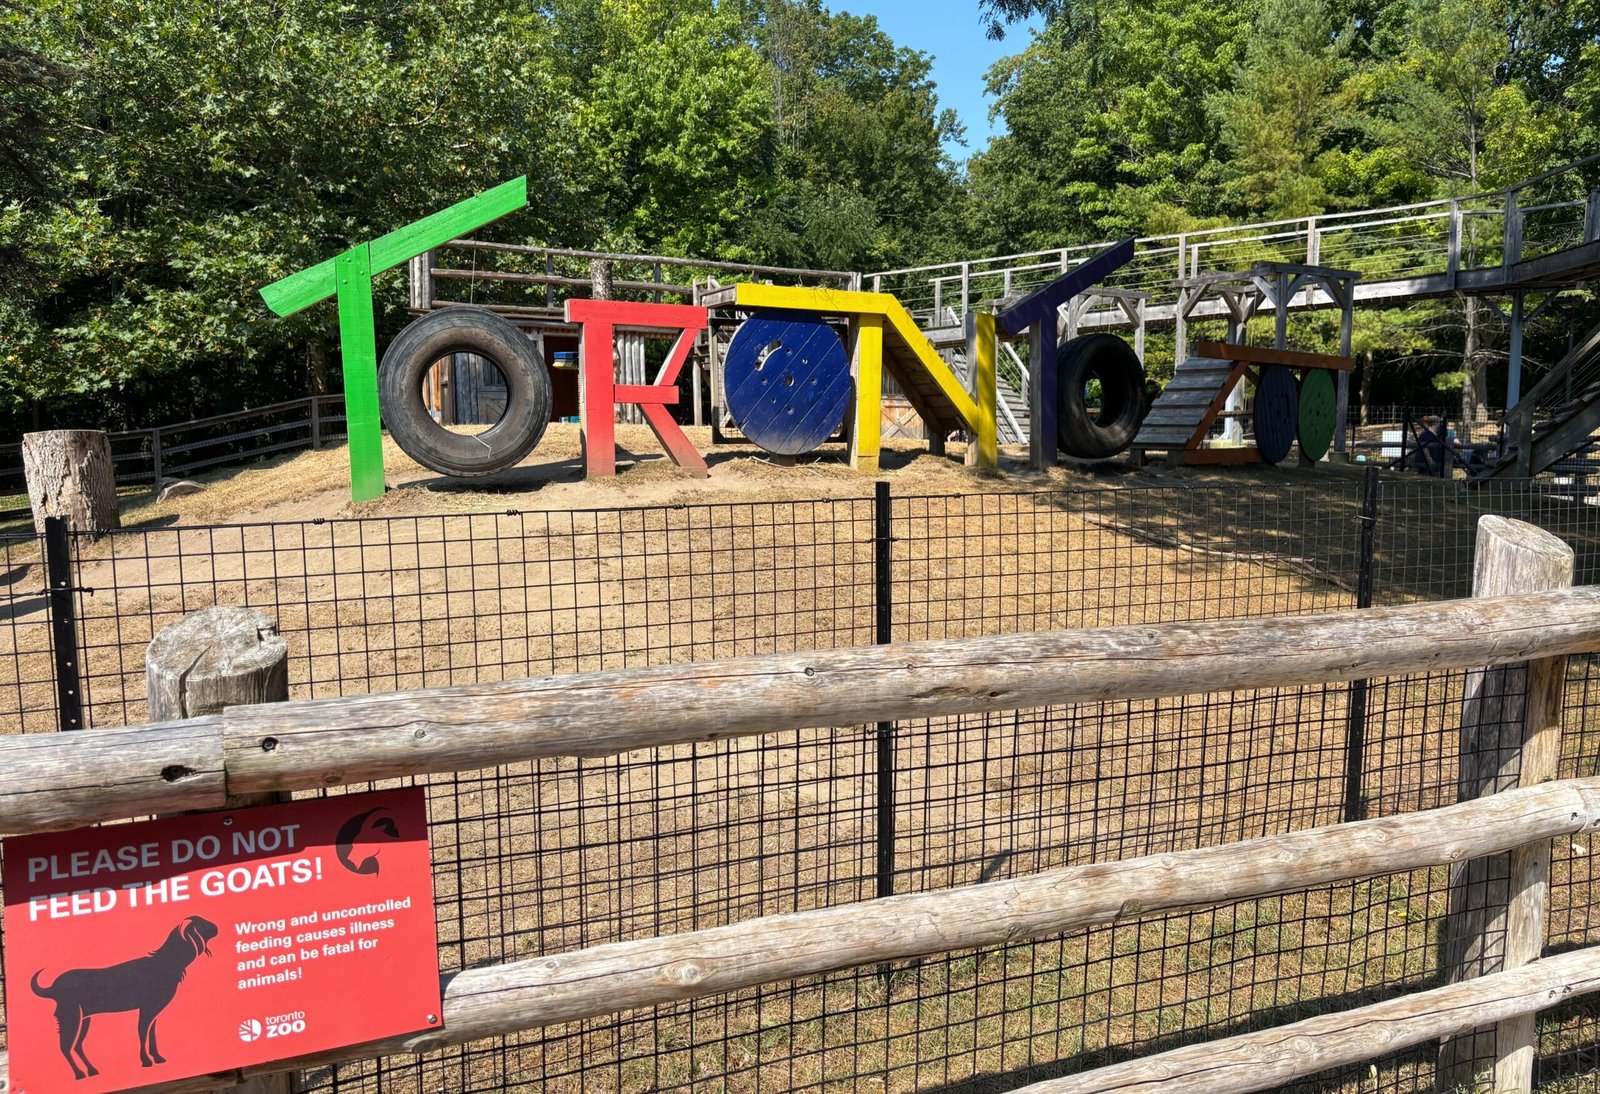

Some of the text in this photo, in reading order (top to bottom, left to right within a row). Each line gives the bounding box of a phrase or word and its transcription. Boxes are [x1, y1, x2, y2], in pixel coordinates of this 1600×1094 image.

[28, 824, 300, 882] PLEASE DO NOT
[29, 856, 323, 921] FEED THE GOATS!
[235, 896, 411, 936] Wrong and uncontrolled
[235, 918, 395, 953] feeding causes illness
[237, 938, 378, 972] and can be fatal for
[237, 966, 303, 990] animals!
[265, 1010, 305, 1025] toronto
